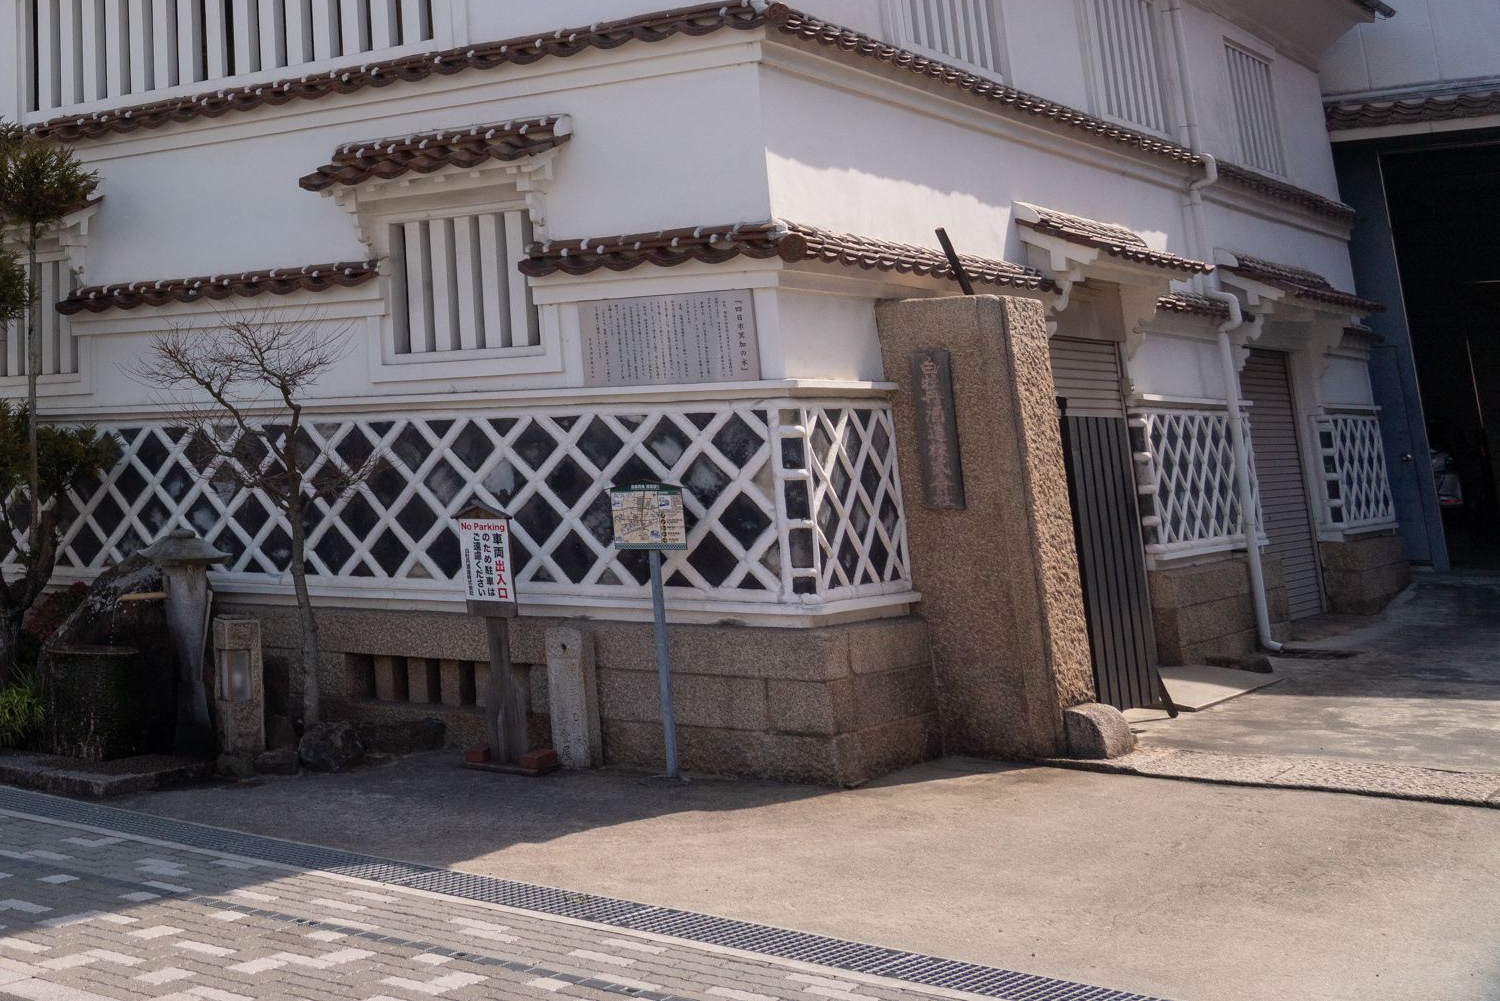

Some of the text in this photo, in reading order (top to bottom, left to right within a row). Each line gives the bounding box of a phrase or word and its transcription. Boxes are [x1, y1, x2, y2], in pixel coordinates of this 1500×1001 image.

[473, 523, 505, 532] Parking
[473, 533, 486, 597] ご遠慮ください
[482, 533, 496, 597] のため駐車は
[492, 533, 508, 599] 車両出入口
